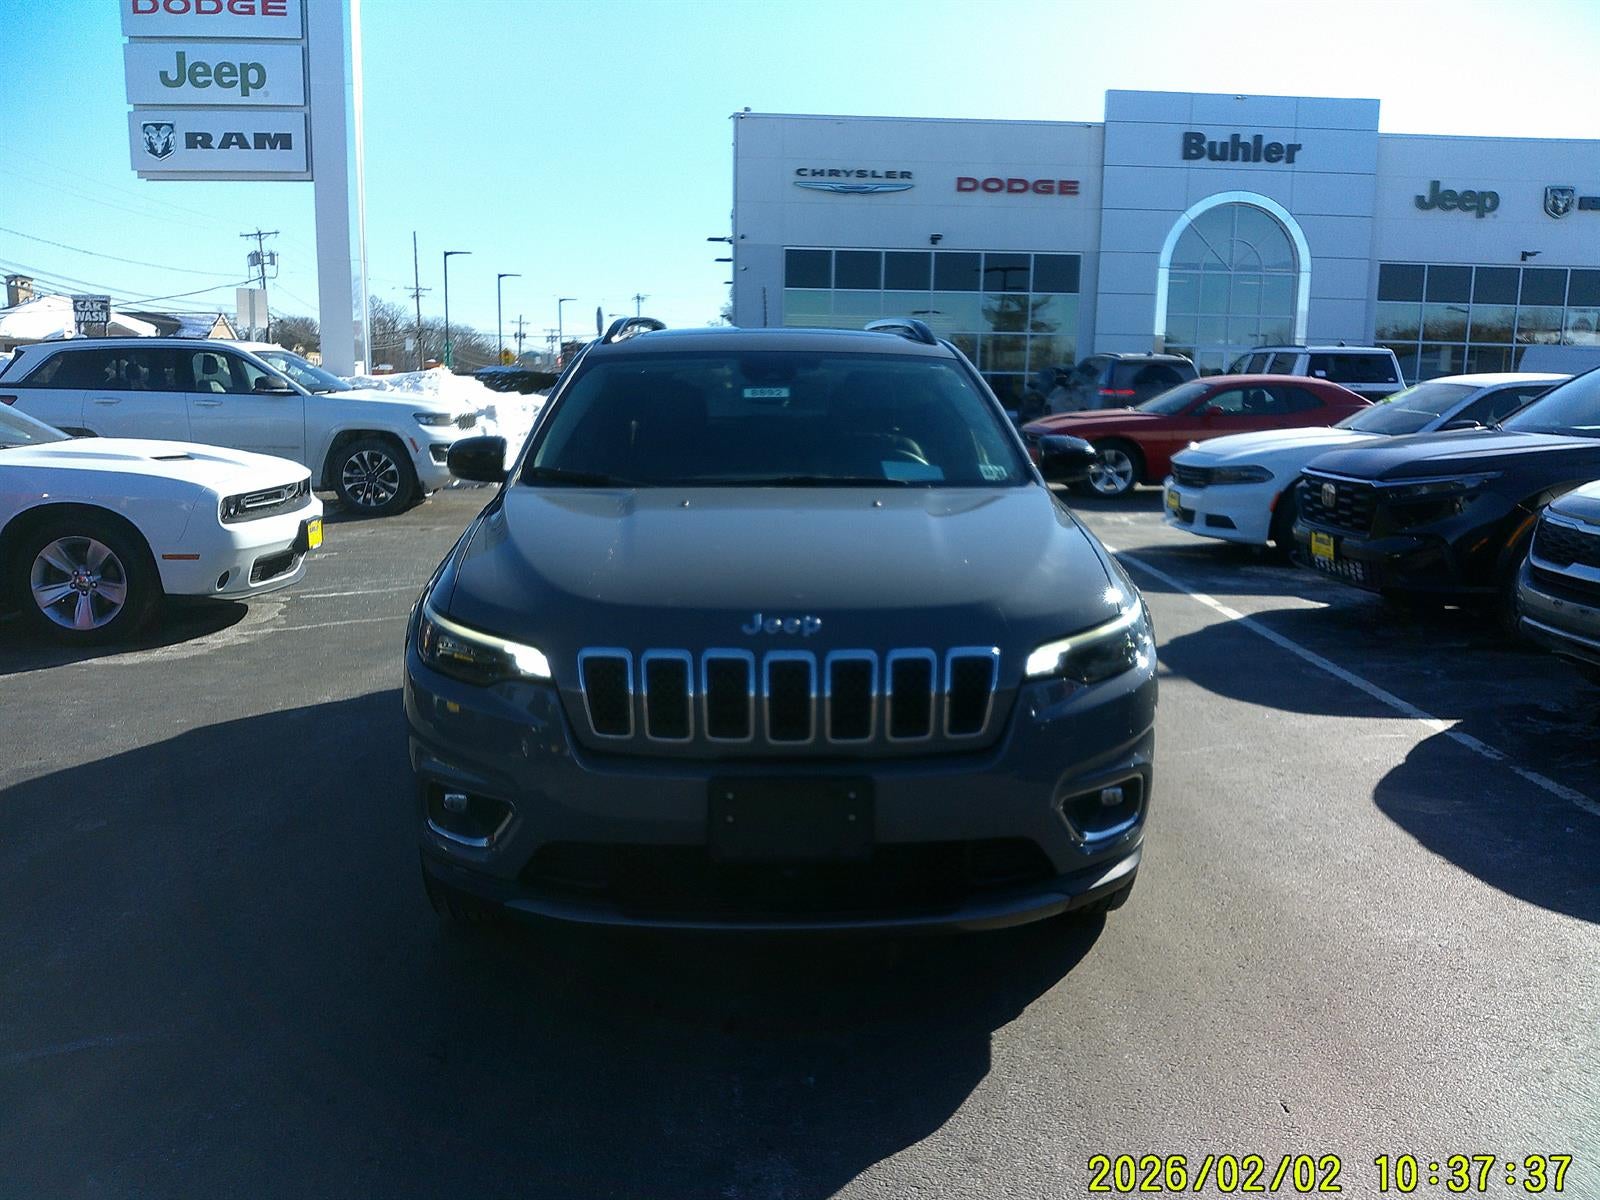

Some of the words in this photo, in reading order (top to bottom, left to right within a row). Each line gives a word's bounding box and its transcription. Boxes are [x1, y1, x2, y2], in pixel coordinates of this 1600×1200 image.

[132, 0, 288, 16] DODGE
[159, 51, 267, 97] Jeep
[184, 132, 293, 150] RAM
[1182, 131, 1303, 164] Buhler
[795, 167, 912, 180] CHRYSLER
[956, 177, 1080, 195] DODGE
[1415, 180, 1500, 218] Jeep
[76, 301, 102, 311] CAR
[75, 311, 107, 321] WASH
[741, 613, 822, 636] Jeep
